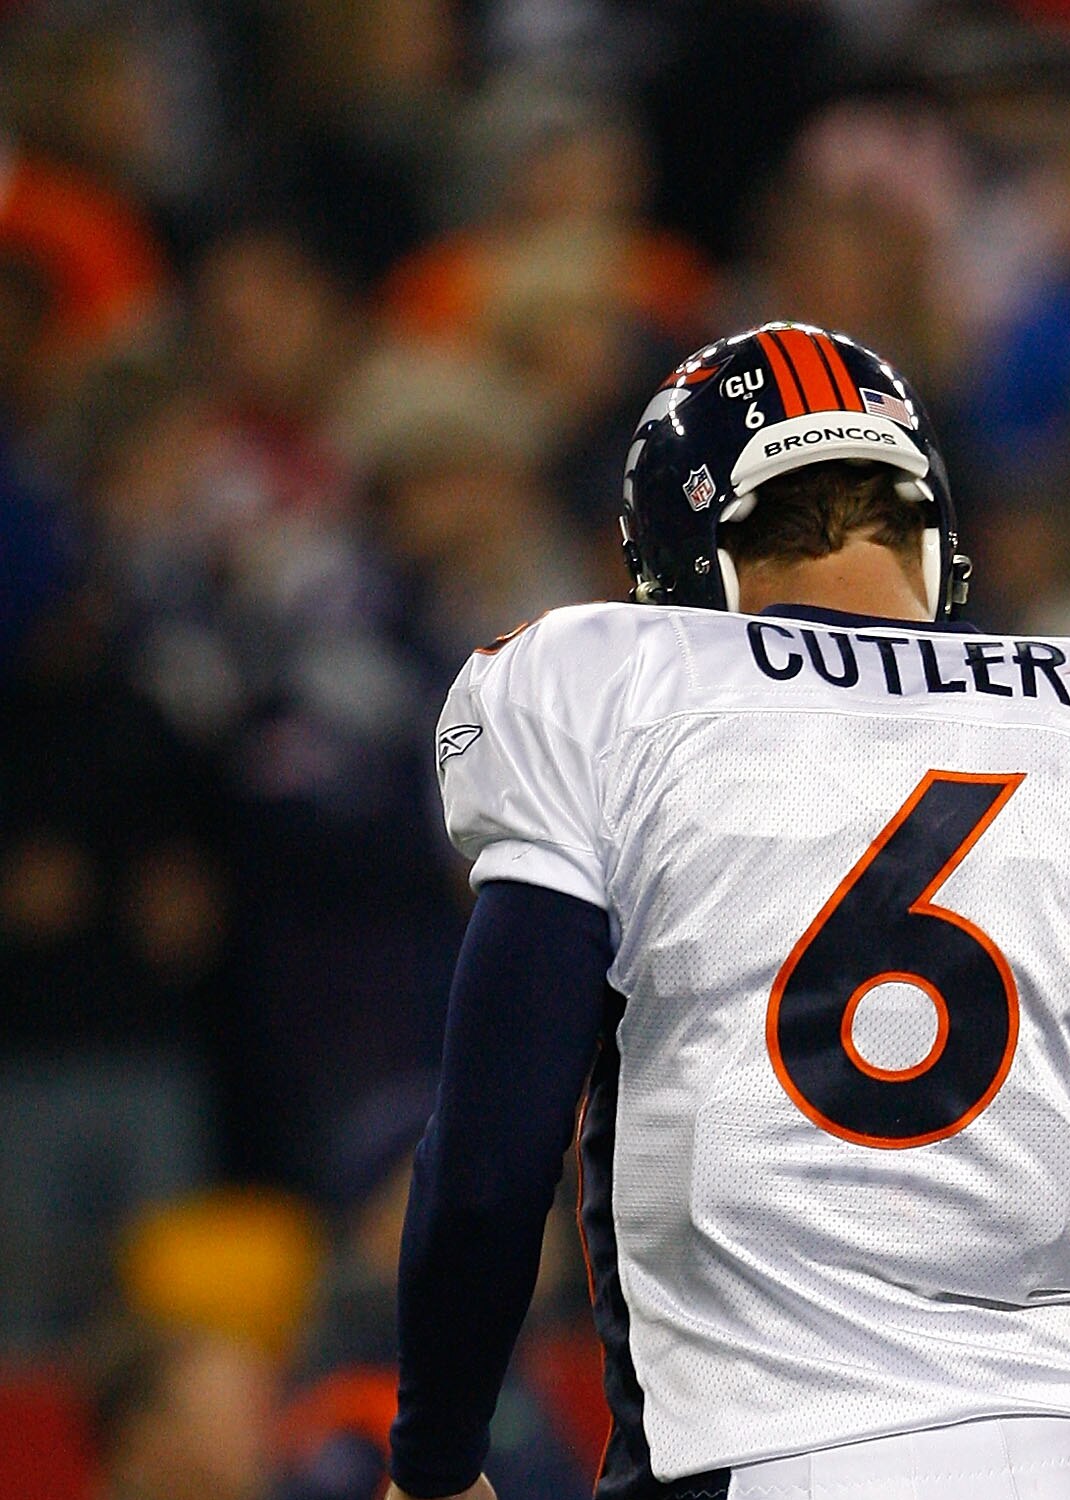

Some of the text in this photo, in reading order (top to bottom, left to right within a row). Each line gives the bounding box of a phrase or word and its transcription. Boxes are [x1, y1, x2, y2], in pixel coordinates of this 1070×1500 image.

[725, 368, 765, 398] GU
[745, 401, 765, 430] 6
[764, 427, 896, 457] BRONCOS
[691, 483, 711, 506] NFL
[766, 769, 1027, 1150] 6
